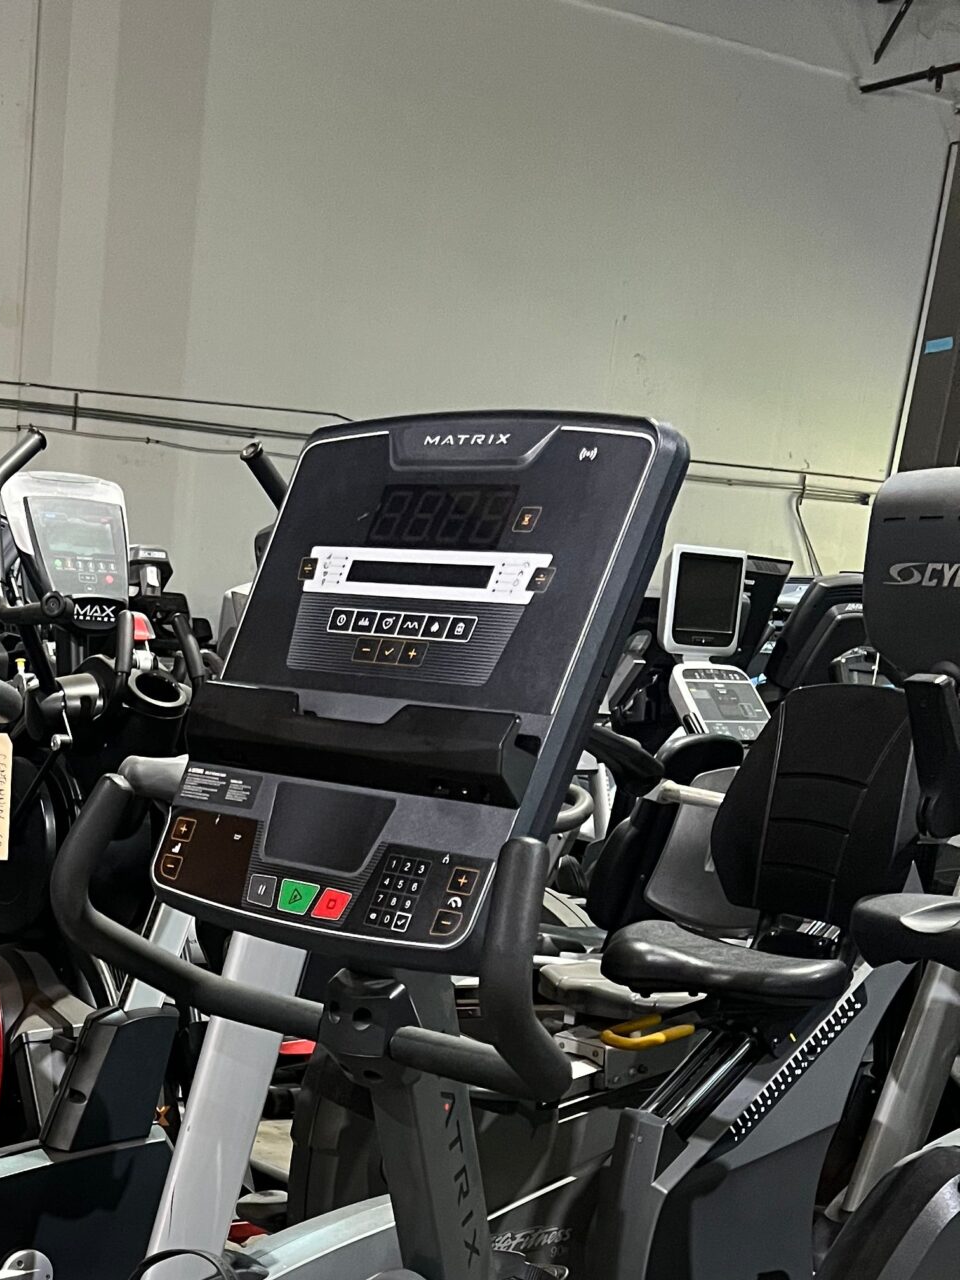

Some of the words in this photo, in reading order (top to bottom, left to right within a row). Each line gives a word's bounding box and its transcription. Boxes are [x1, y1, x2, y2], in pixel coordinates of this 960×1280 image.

[424, 433, 511, 446] MATRIX
[74, 604, 116, 617] MAX
[391, 860, 396, 869] 1
[404, 862, 411, 872] 2
[418, 865, 425, 874] 3
[383, 877, 390, 886] 4
[397, 879, 404, 889] 5
[411, 882, 418, 892] 6
[377, 894, 384, 903] 7
[390, 897, 397, 906] 8
[405, 900, 411, 909] 9
[384, 914, 391, 924] 0
[440, 1091, 481, 1269] ATRIX
